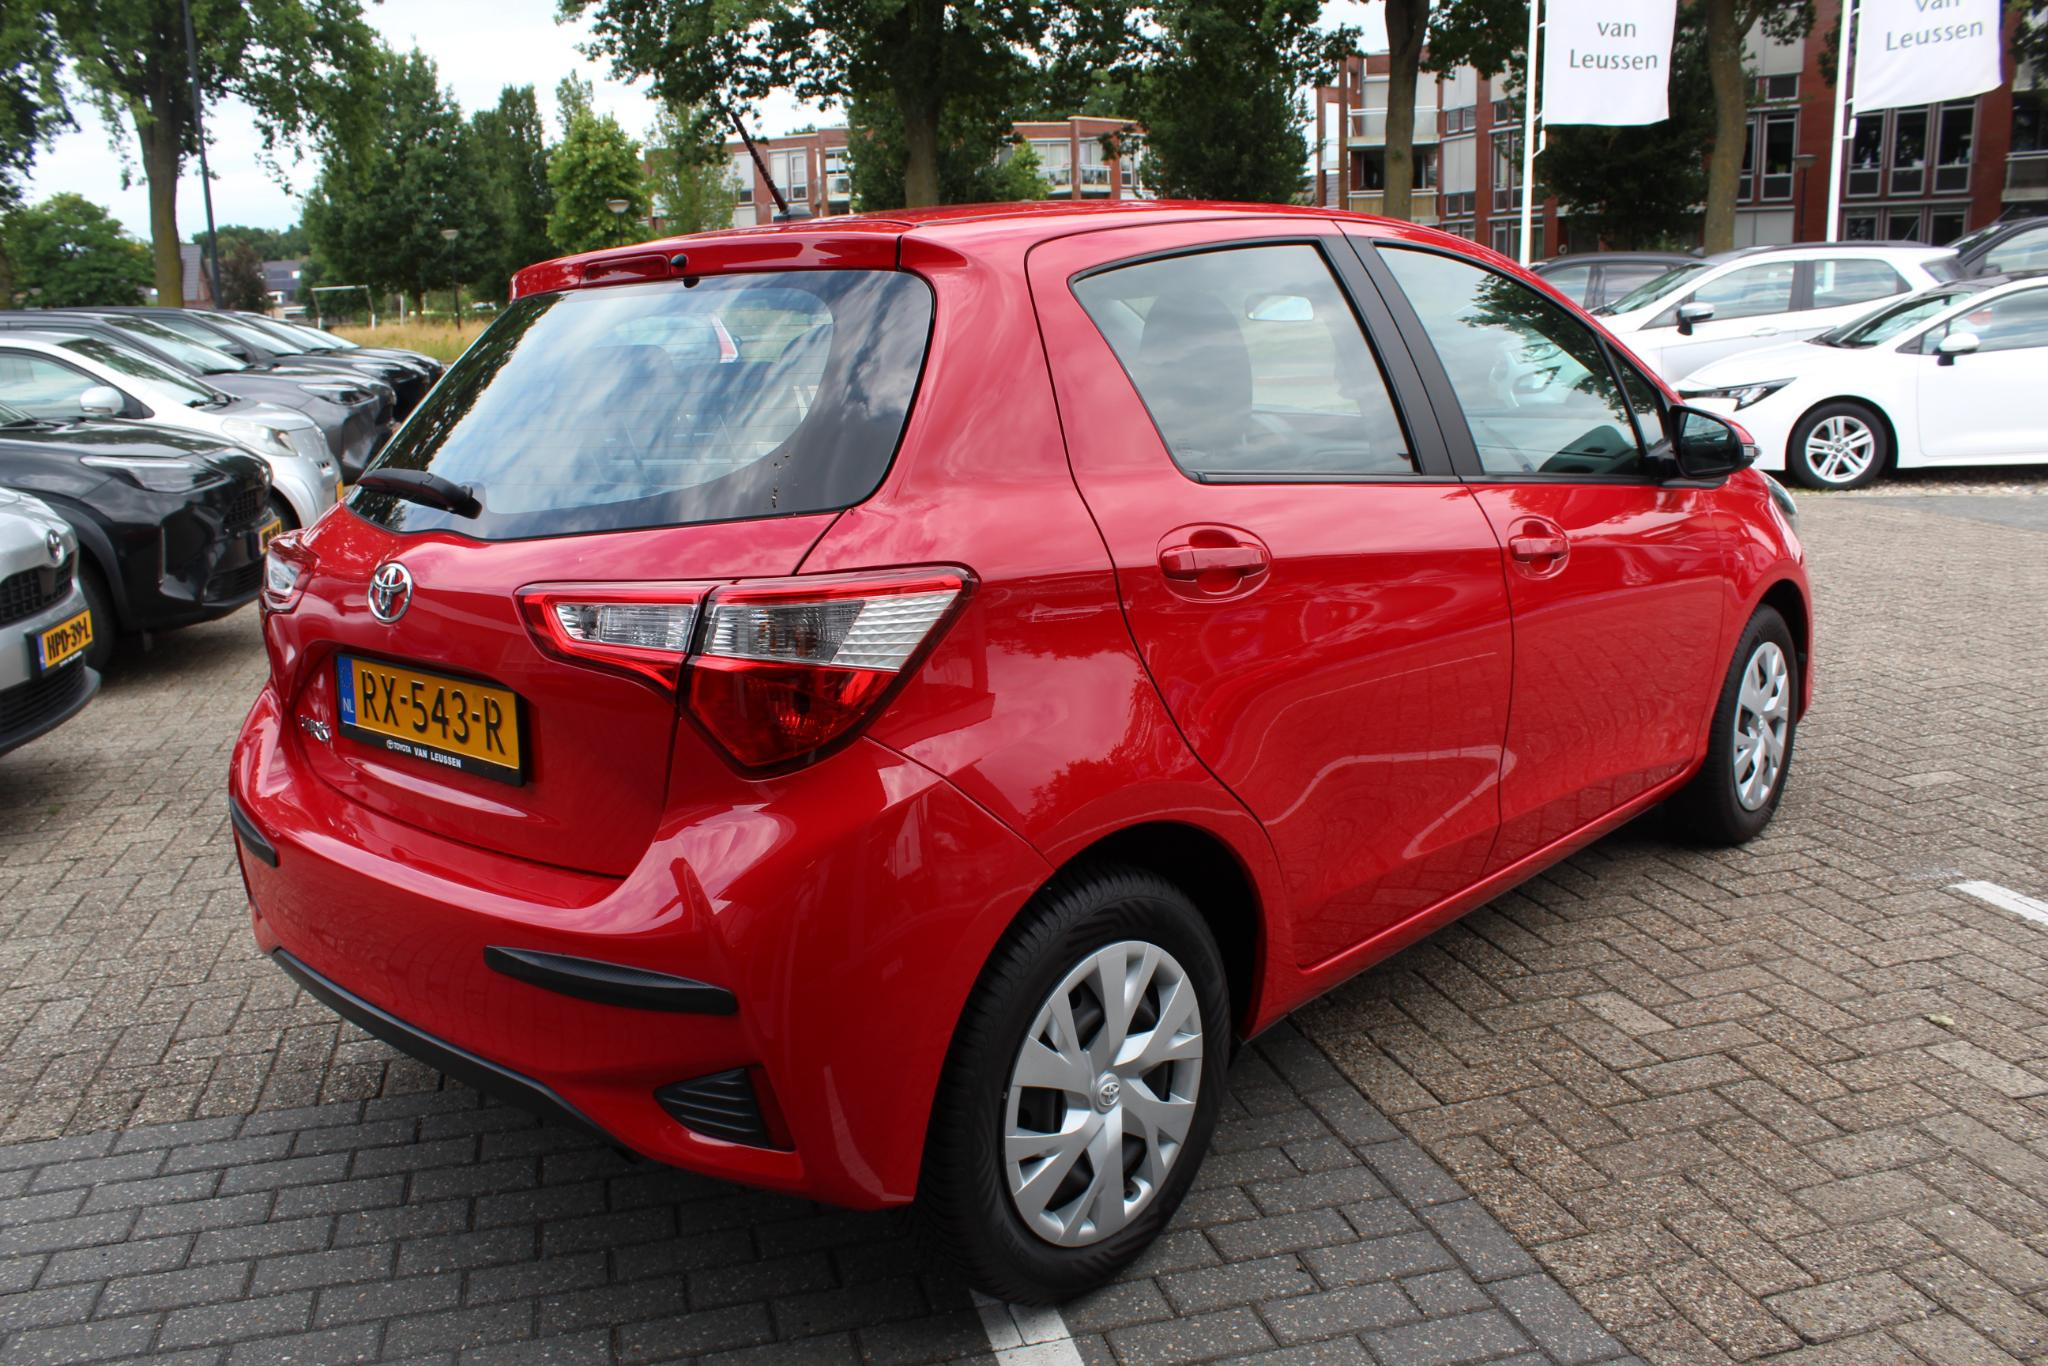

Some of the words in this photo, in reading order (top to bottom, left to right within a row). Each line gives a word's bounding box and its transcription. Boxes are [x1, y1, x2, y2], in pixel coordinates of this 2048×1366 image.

[1597, 21, 1637, 38] van
[1886, 20, 1983, 51] Leussen
[1569, 48, 1659, 71] Leussen
[342, 696, 355, 713] NL
[361, 669, 506, 755] RX-543-R
[393, 741, 412, 753] TOYOTA
[414, 746, 428, 759] VAN
[430, 751, 462, 768] LEUSSEN
